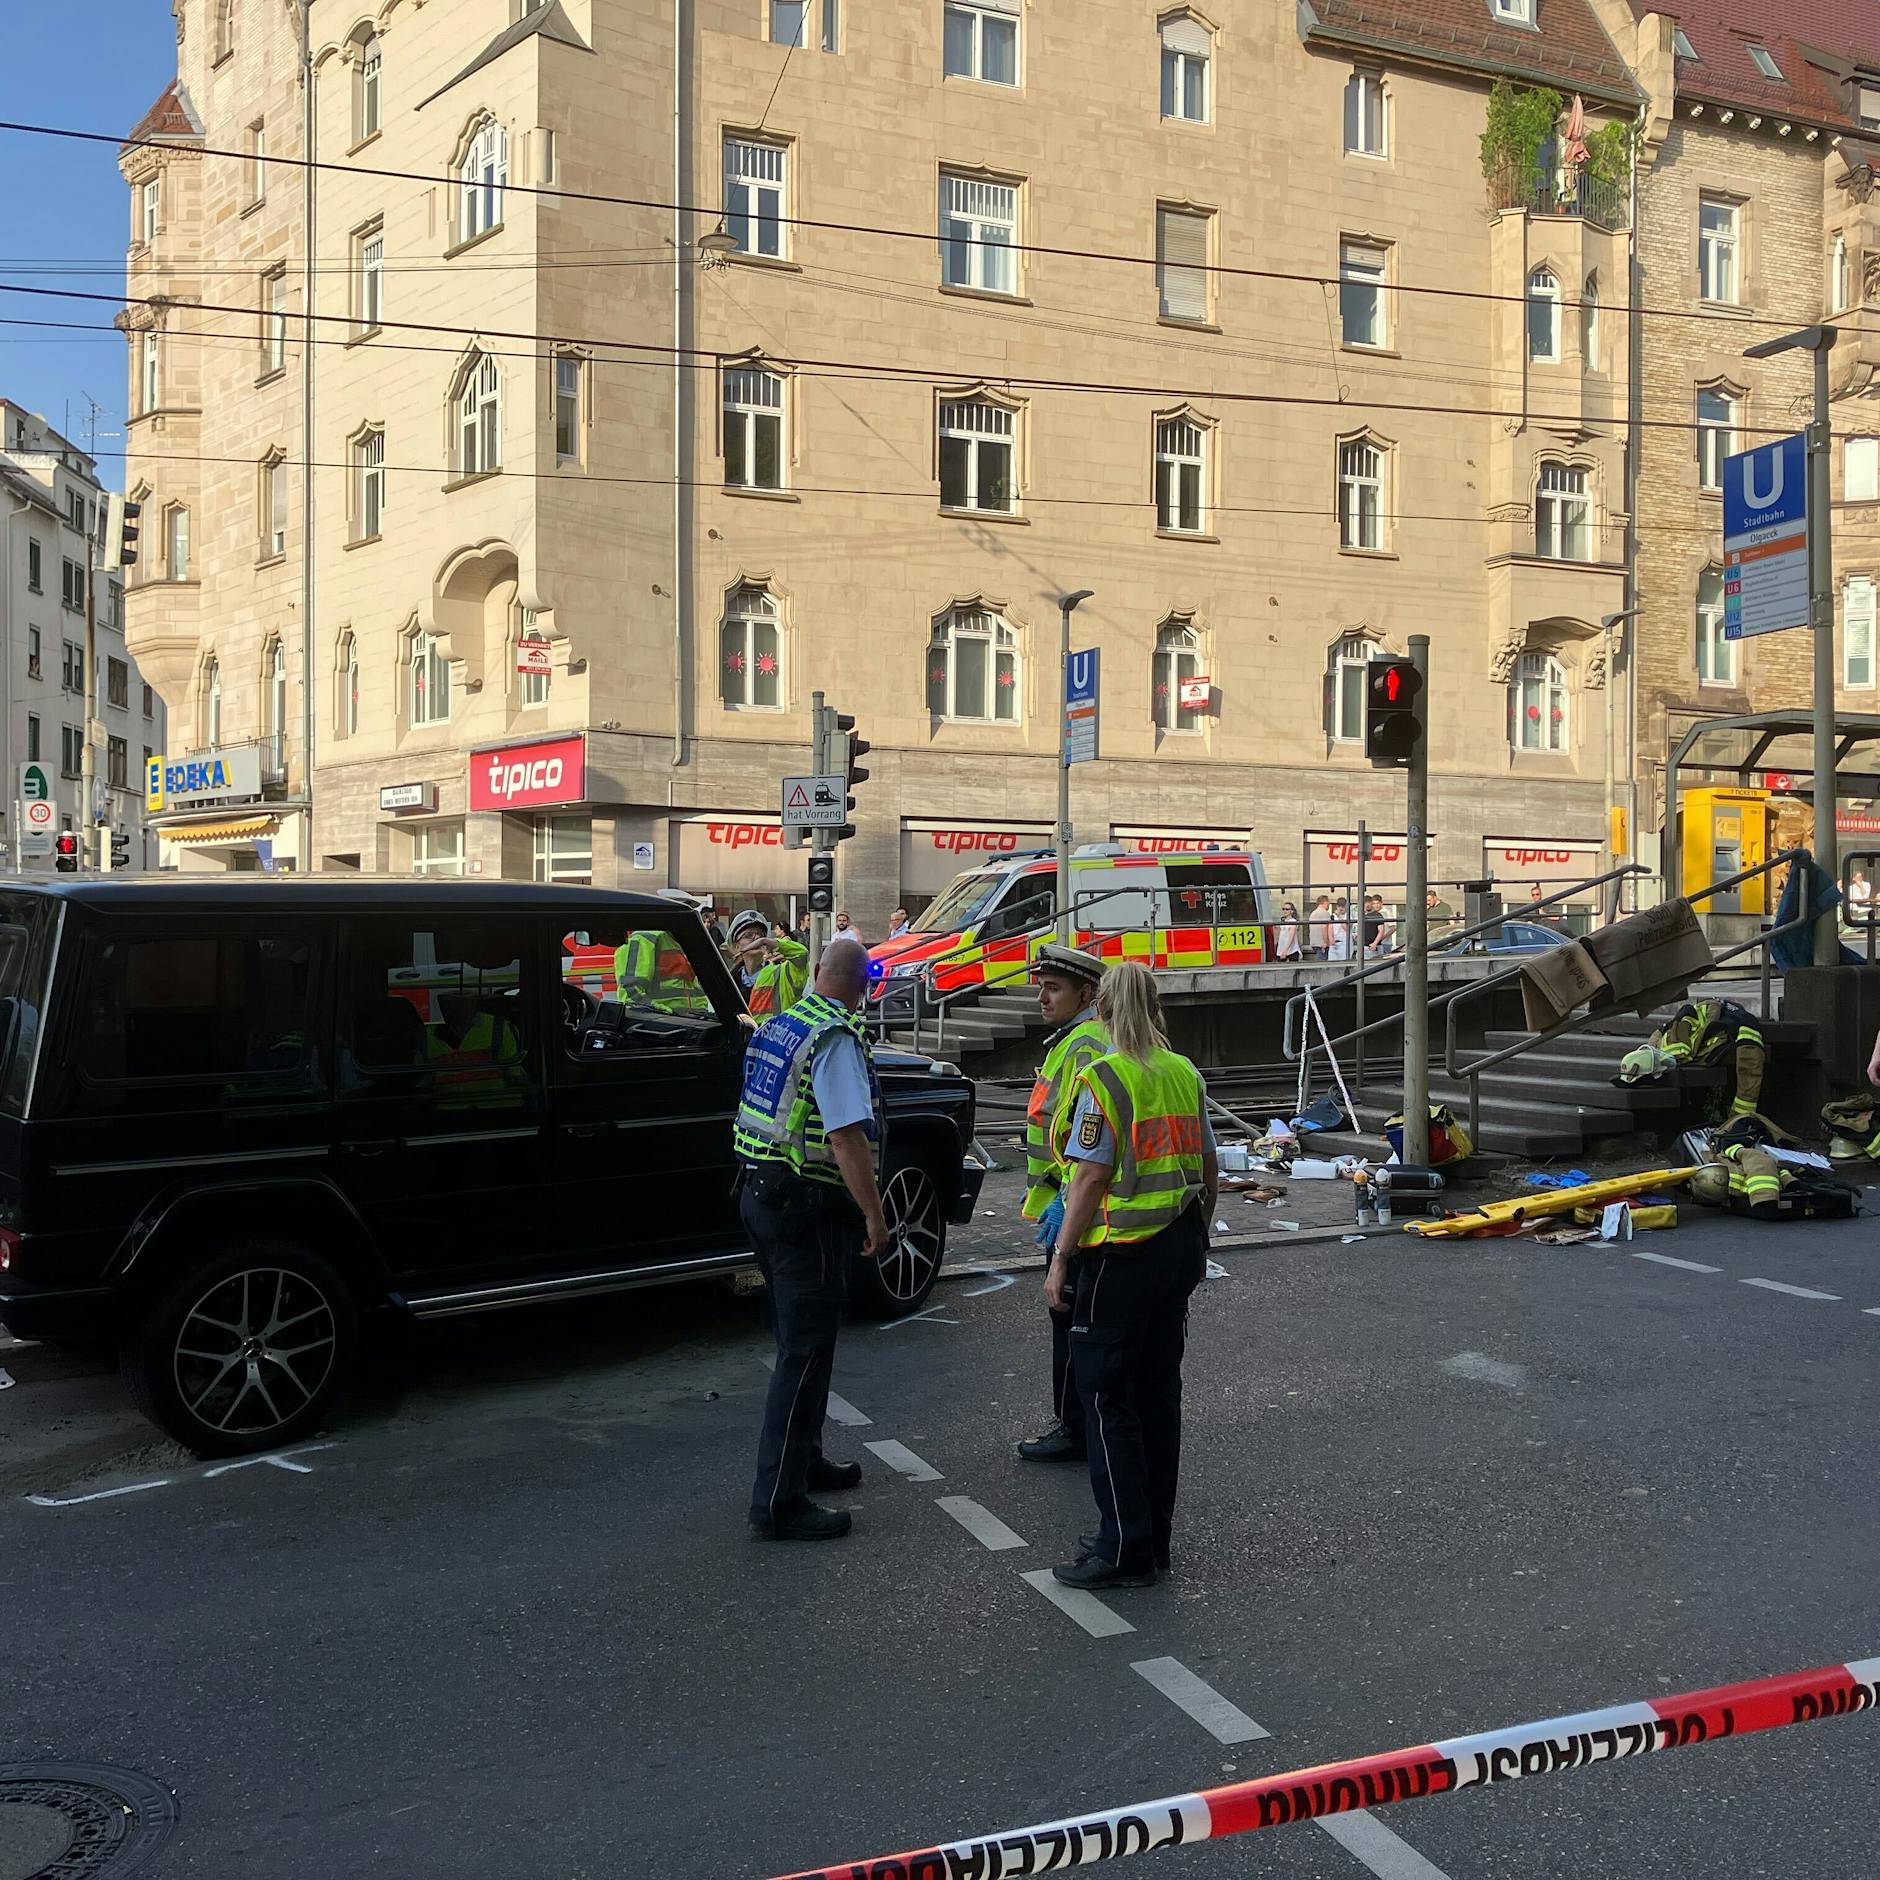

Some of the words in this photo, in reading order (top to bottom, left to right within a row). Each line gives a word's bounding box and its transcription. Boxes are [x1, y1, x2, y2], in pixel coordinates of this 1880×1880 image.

[1743, 445, 1784, 510] U
[1743, 509, 1785, 529] Stadtbahn
[1727, 626, 1740, 637] U15
[1073, 652, 1089, 690] U
[150, 764, 160, 794] E
[165, 760, 226, 793] EDEKA
[488, 755, 563, 800] tipico
[33, 808, 47, 818] 30
[787, 808, 803, 820] hat
[805, 808, 842, 822] Vorrang
[932, 831, 1016, 854] tipico
[1327, 843, 1400, 864] tipco
[1504, 848, 1571, 866] tipico
[1204, 892, 1226, 900] Roes
[1231, 930, 1256, 946] 112
